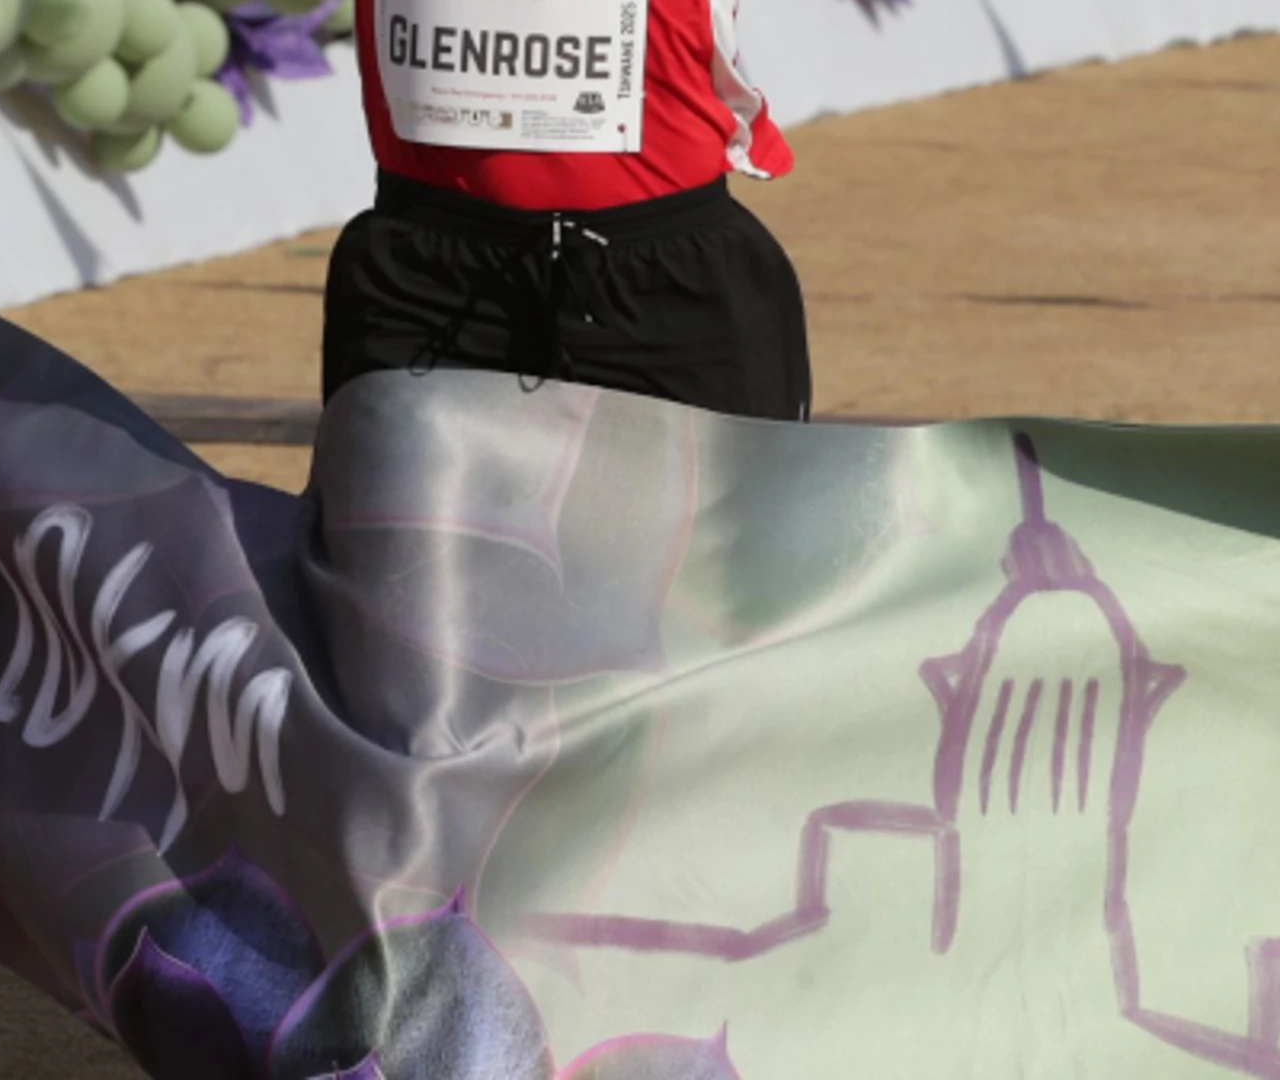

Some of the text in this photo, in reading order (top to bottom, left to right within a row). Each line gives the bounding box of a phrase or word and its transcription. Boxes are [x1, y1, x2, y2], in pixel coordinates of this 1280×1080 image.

[389, 14, 612, 80] GLENROSE
[616, 1, 636, 101] TSHWANE 2025
